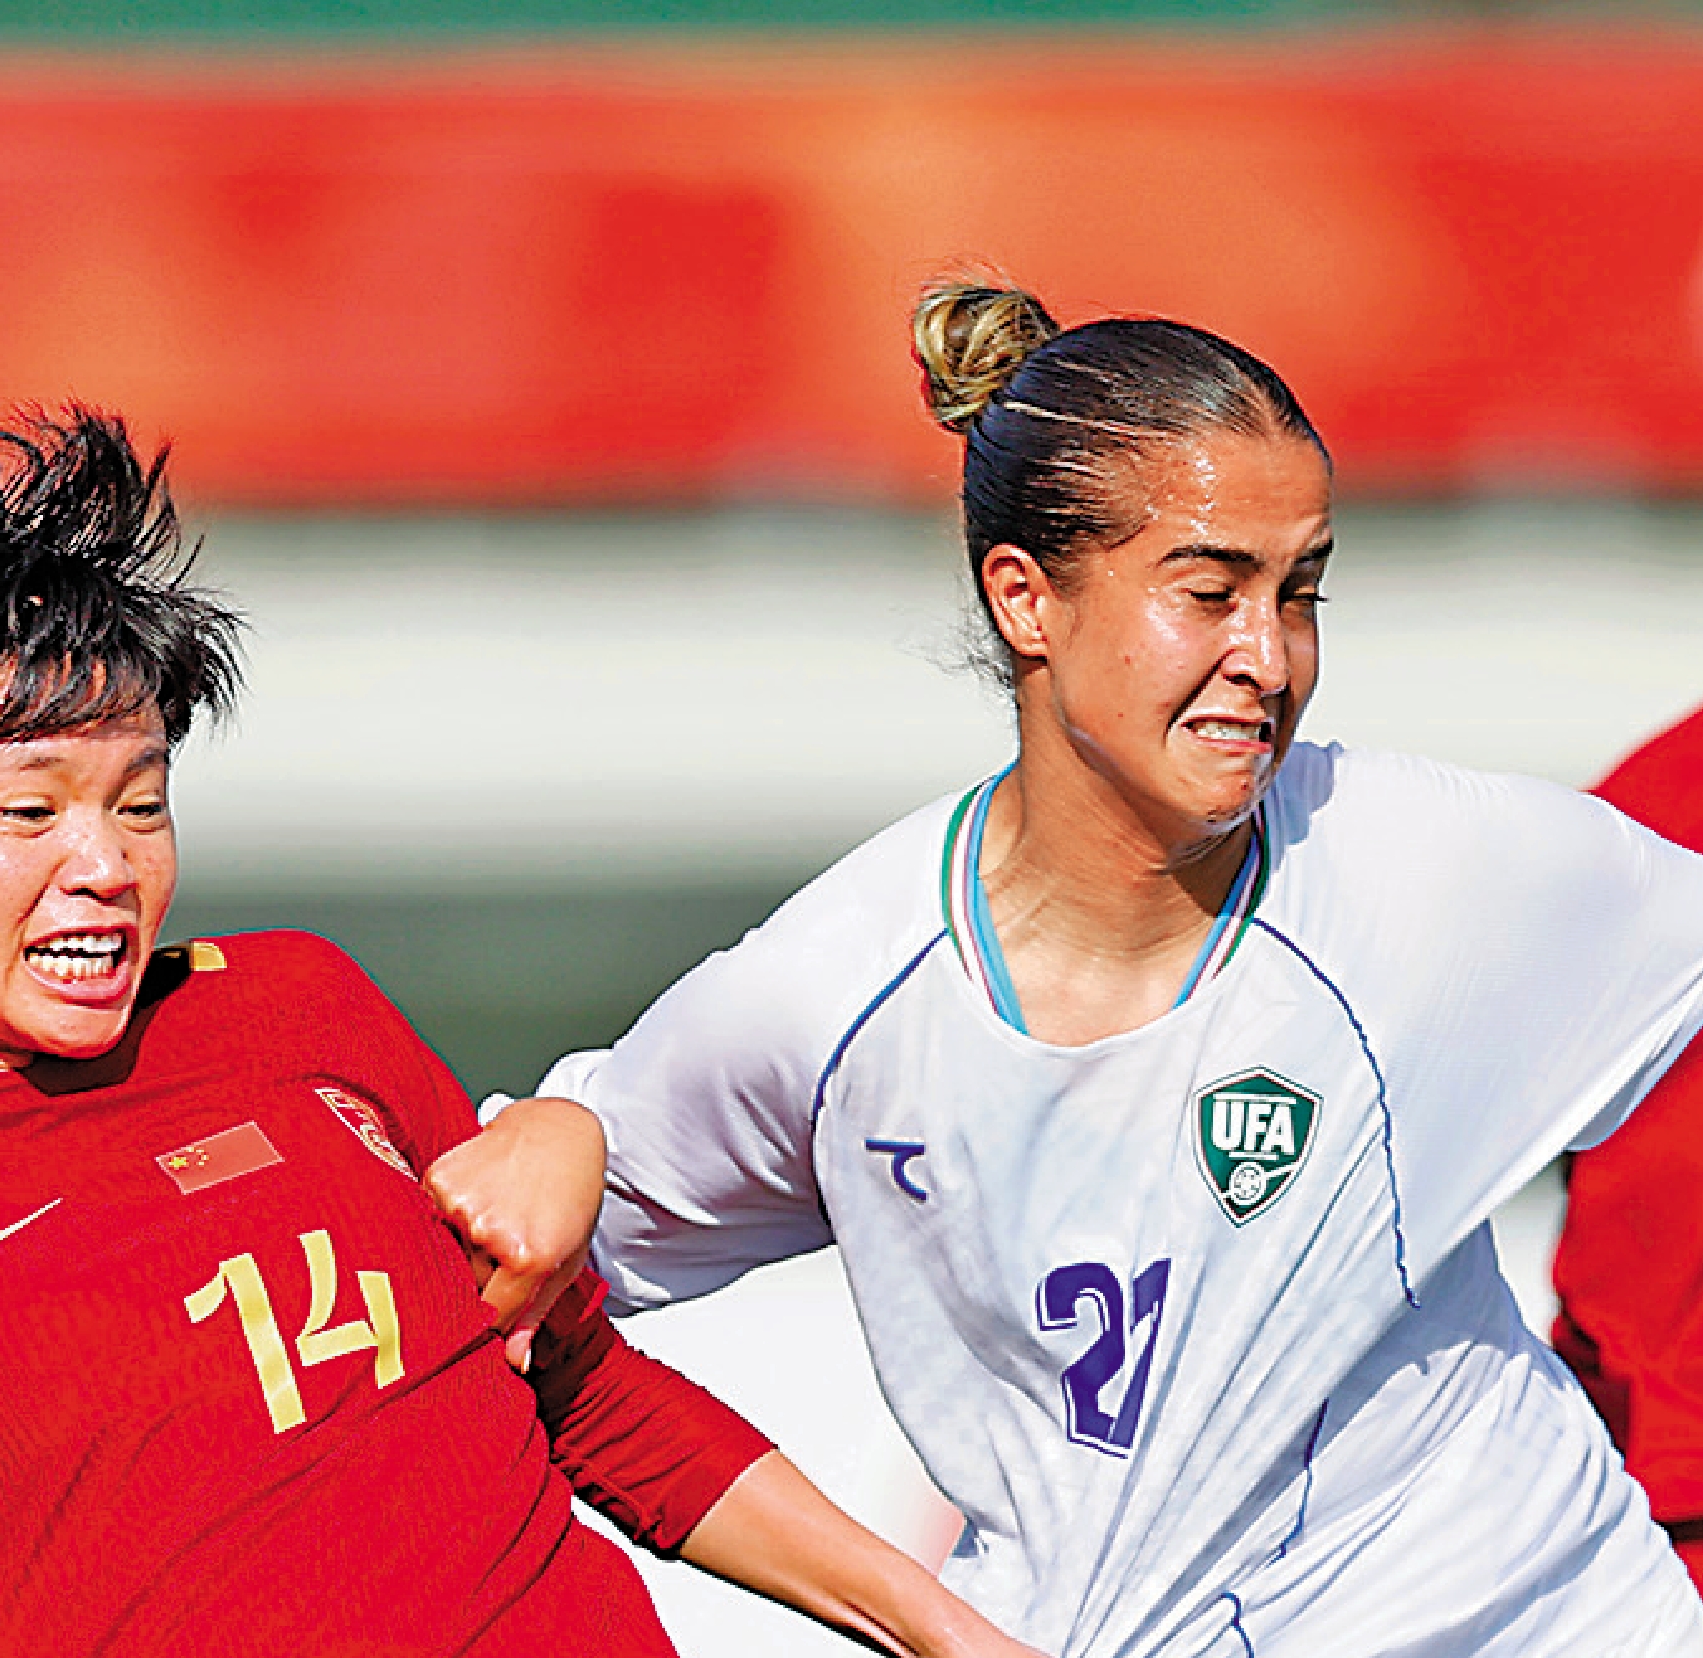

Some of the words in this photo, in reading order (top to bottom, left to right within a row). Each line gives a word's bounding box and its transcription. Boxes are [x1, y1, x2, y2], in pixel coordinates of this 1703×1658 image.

[1212, 1100, 1296, 1156] UFA
[183, 1228, 405, 1434] 14
[1035, 1257, 1172, 1459] 21
